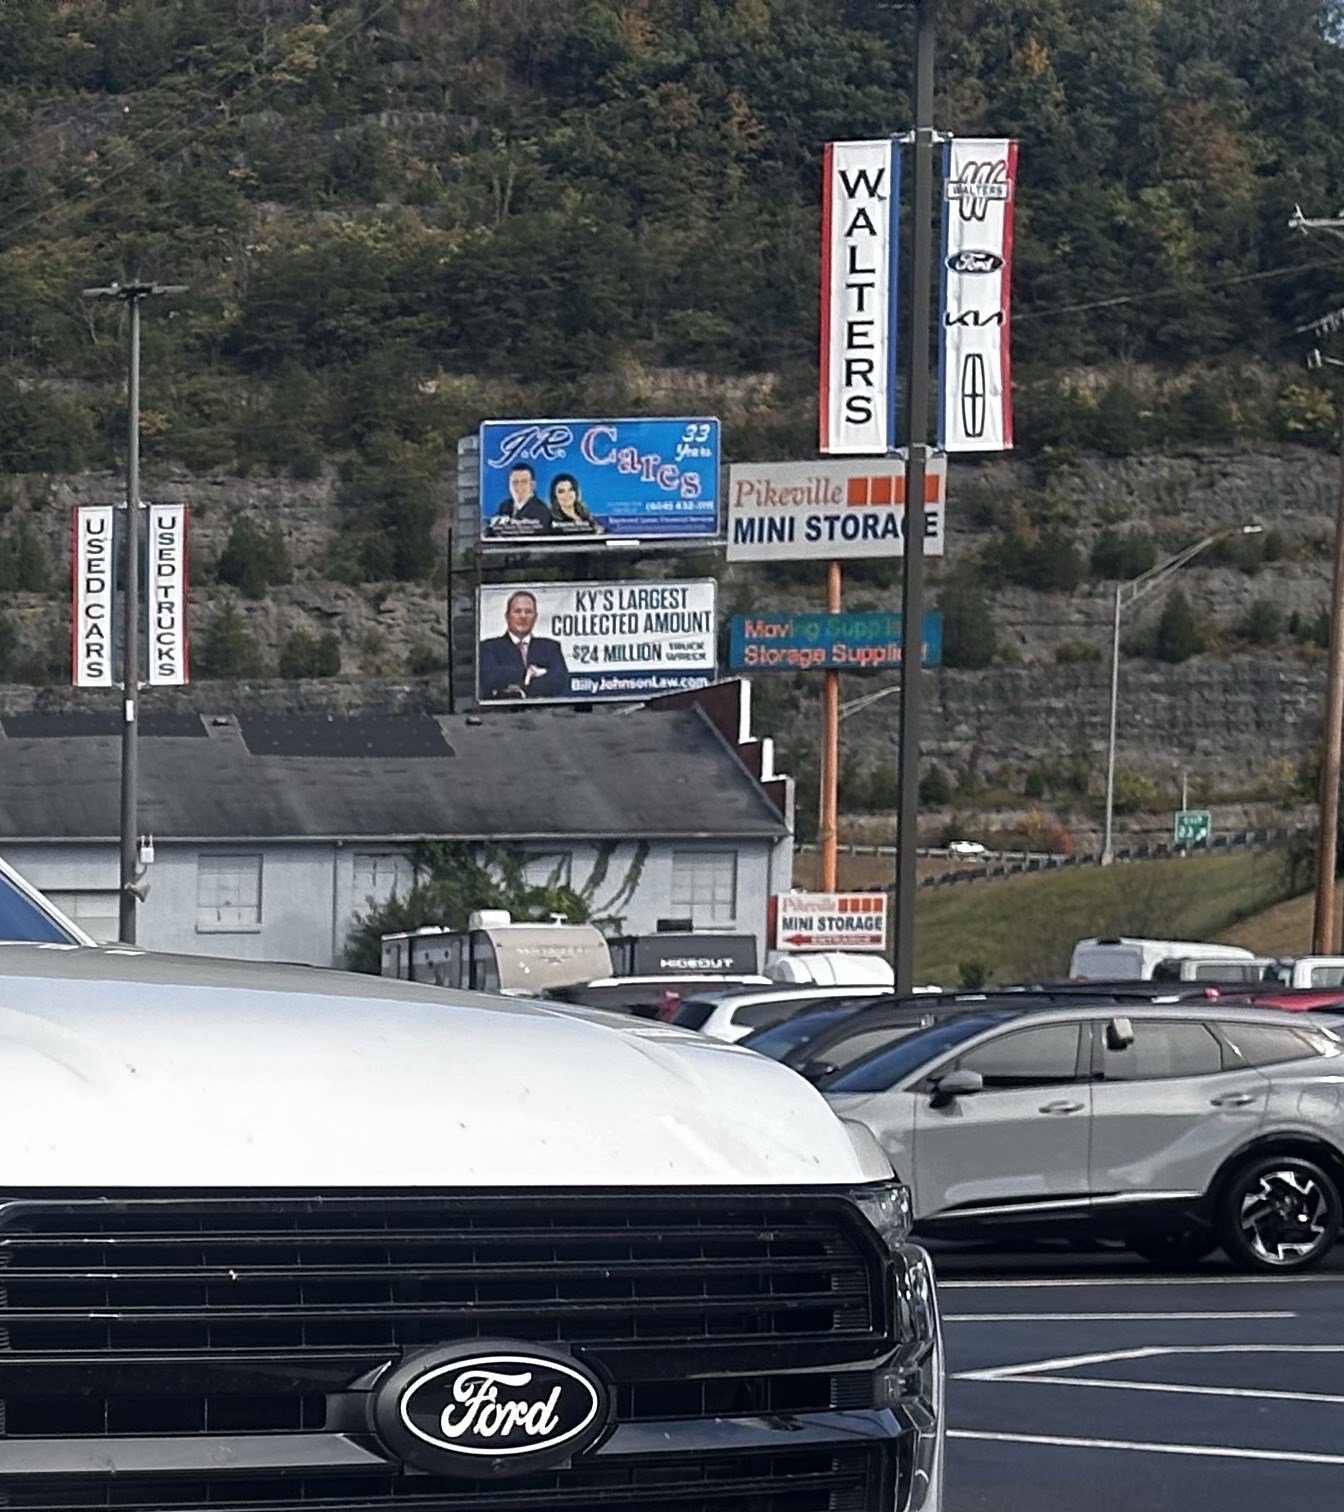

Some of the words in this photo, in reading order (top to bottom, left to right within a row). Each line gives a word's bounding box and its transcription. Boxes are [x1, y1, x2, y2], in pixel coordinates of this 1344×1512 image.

[953, 183, 1003, 196] WALTERS
[955, 253, 995, 271] Ford
[838, 167, 886, 425] WALTERS
[682, 423, 711, 442] 33
[581, 425, 702, 499] Cares
[733, 476, 843, 508] Pikeville
[733, 515, 795, 545] MINI
[804, 511, 939, 542] STORAE
[85, 518, 105, 594] USED
[157, 516, 176, 577] USED
[575, 589, 613, 613] KY'S
[618, 587, 689, 610] LARGEST
[156, 585, 176, 677] TRUCKS
[551, 613, 638, 637] COLLECTED
[643, 610, 712, 633] AMOUNT
[85, 603, 106, 678] CARS
[572, 644, 599, 664] $24
[603, 643, 662, 662] MILLION
[744, 644, 825, 669] Storage
[570, 675, 709, 694] BillyJohnsonLaw.com
[782, 916, 813, 931] MINI
[817, 915, 882, 931] STORAGE
[441, 1370, 562, 1438] Ford
